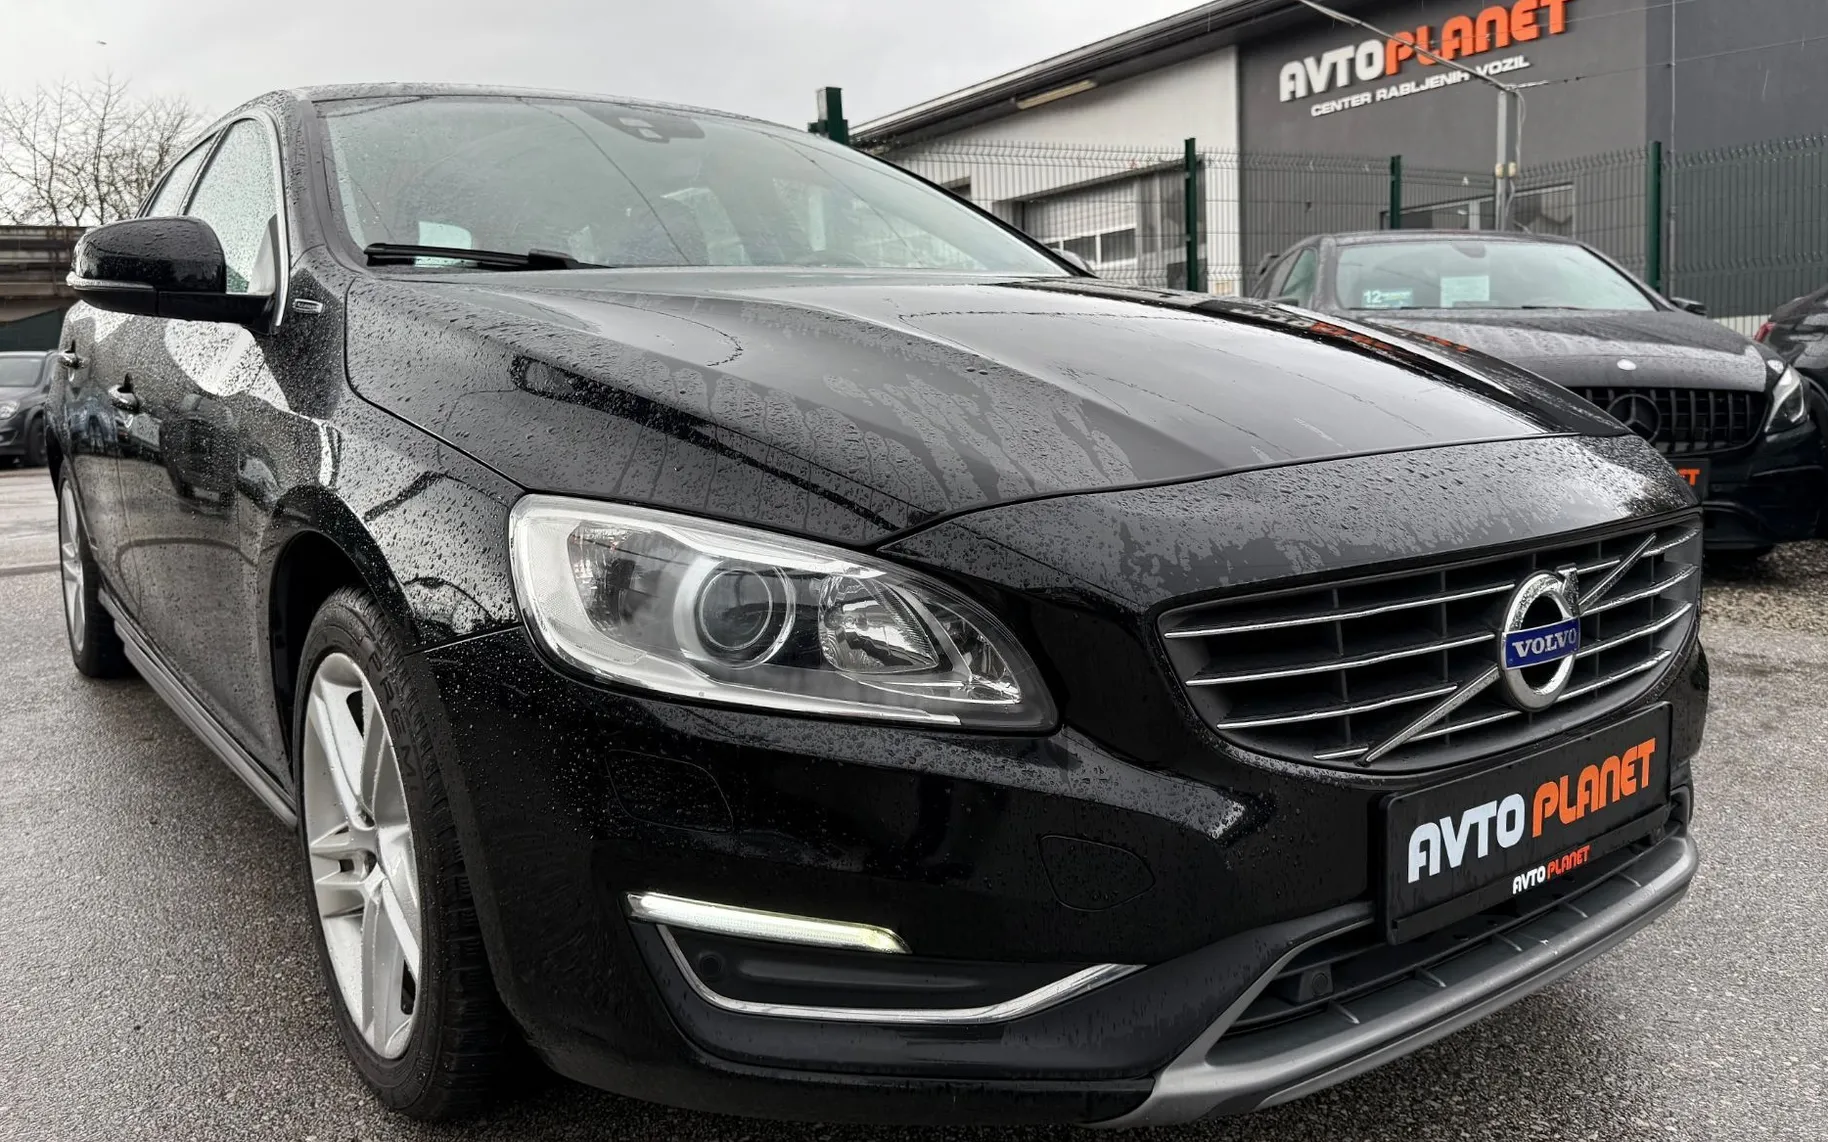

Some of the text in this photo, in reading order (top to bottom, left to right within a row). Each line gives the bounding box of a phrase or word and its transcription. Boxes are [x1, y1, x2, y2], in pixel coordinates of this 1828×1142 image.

[1310, 55, 1531, 117] CENTER RABLJENIH VOZIL
[1511, 627, 1577, 658] VOLVO
[1408, 737, 1656, 883] AVTO PLANET
[1512, 844, 1590, 895] AVTO PLANET
